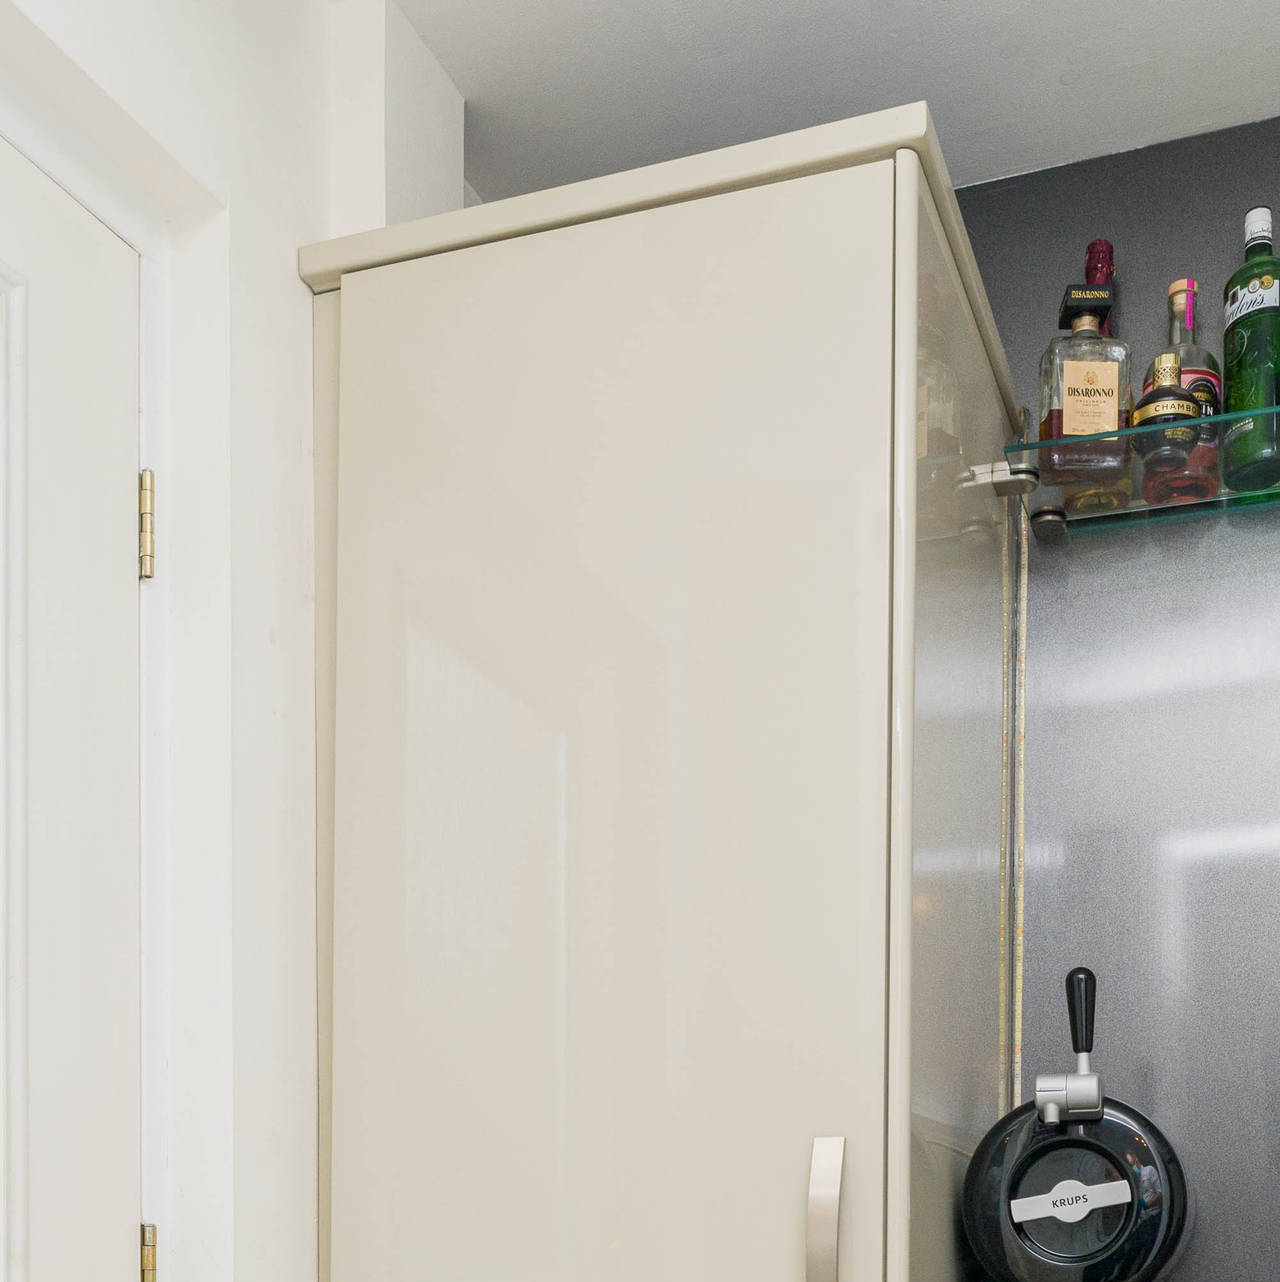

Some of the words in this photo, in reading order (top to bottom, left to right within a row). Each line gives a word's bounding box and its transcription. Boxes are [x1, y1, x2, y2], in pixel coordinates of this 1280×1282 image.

[1071, 290, 1110, 300] DISARONNO
[1067, 386, 1114, 398] DISARONNO
[1052, 1194, 1088, 1208] KRUPS
